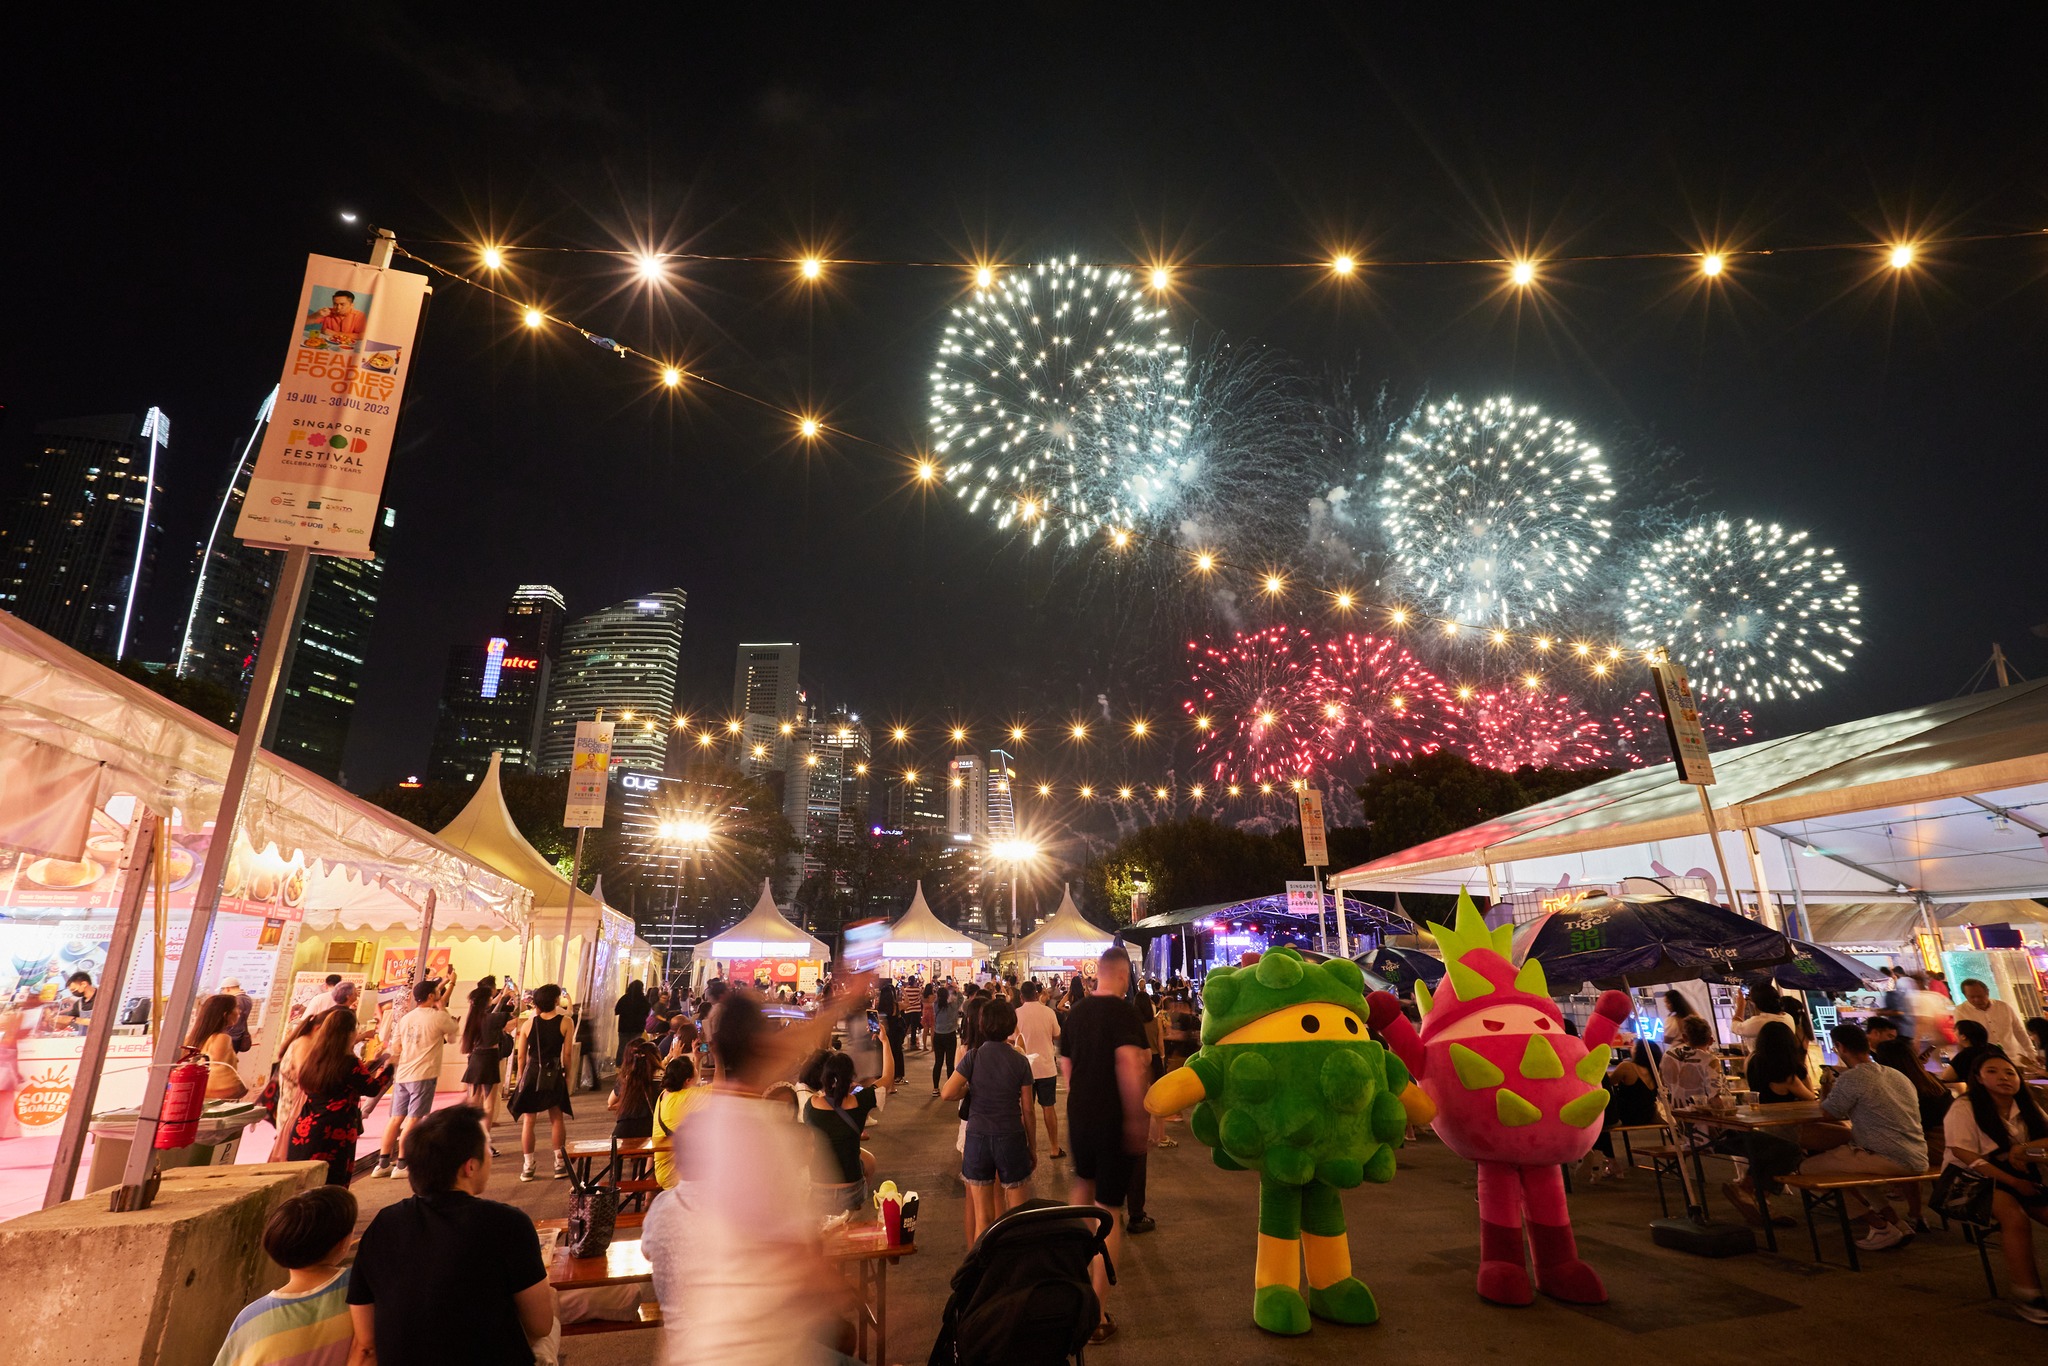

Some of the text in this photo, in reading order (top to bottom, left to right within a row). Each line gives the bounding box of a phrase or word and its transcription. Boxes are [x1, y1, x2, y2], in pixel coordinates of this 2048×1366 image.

[296, 349, 358, 369] REAL
[293, 362, 396, 389] FOODIES
[330, 381, 393, 402] ONLY
[286, 392, 299, 402] 19
[300, 394, 318, 404] JUL
[329, 397, 342, 406] 30
[343, 398, 361, 410] JUL
[363, 402, 390, 416] 2023
[292, 418, 372, 436] SINGAPORE
[283, 448, 364, 467] FESTIVAL
[281, 459, 327, 469] CELEBRATING
[340, 467, 362, 475] YEARS
[307, 521, 324, 529] UOB
[346, 527, 365, 535] Grab
[502, 657, 538, 669] ntuc
[578, 737, 597, 745] REAL
[588, 747, 609, 755] ONLY
[622, 775, 659, 791] OUE
[90, 894, 102, 905] $6
[1564, 916, 1611, 930] Tiger
[1706, 947, 1738, 962] Tiger
[393, 956, 419, 968] DONUT
[1381, 964, 1400, 972] Tiger
[1724, 975, 1744, 984] Tiger
[119, 1044, 149, 1053] HERE
[18, 1092, 71, 1106] SOUR
[18, 1103, 66, 1115] BOMBE
